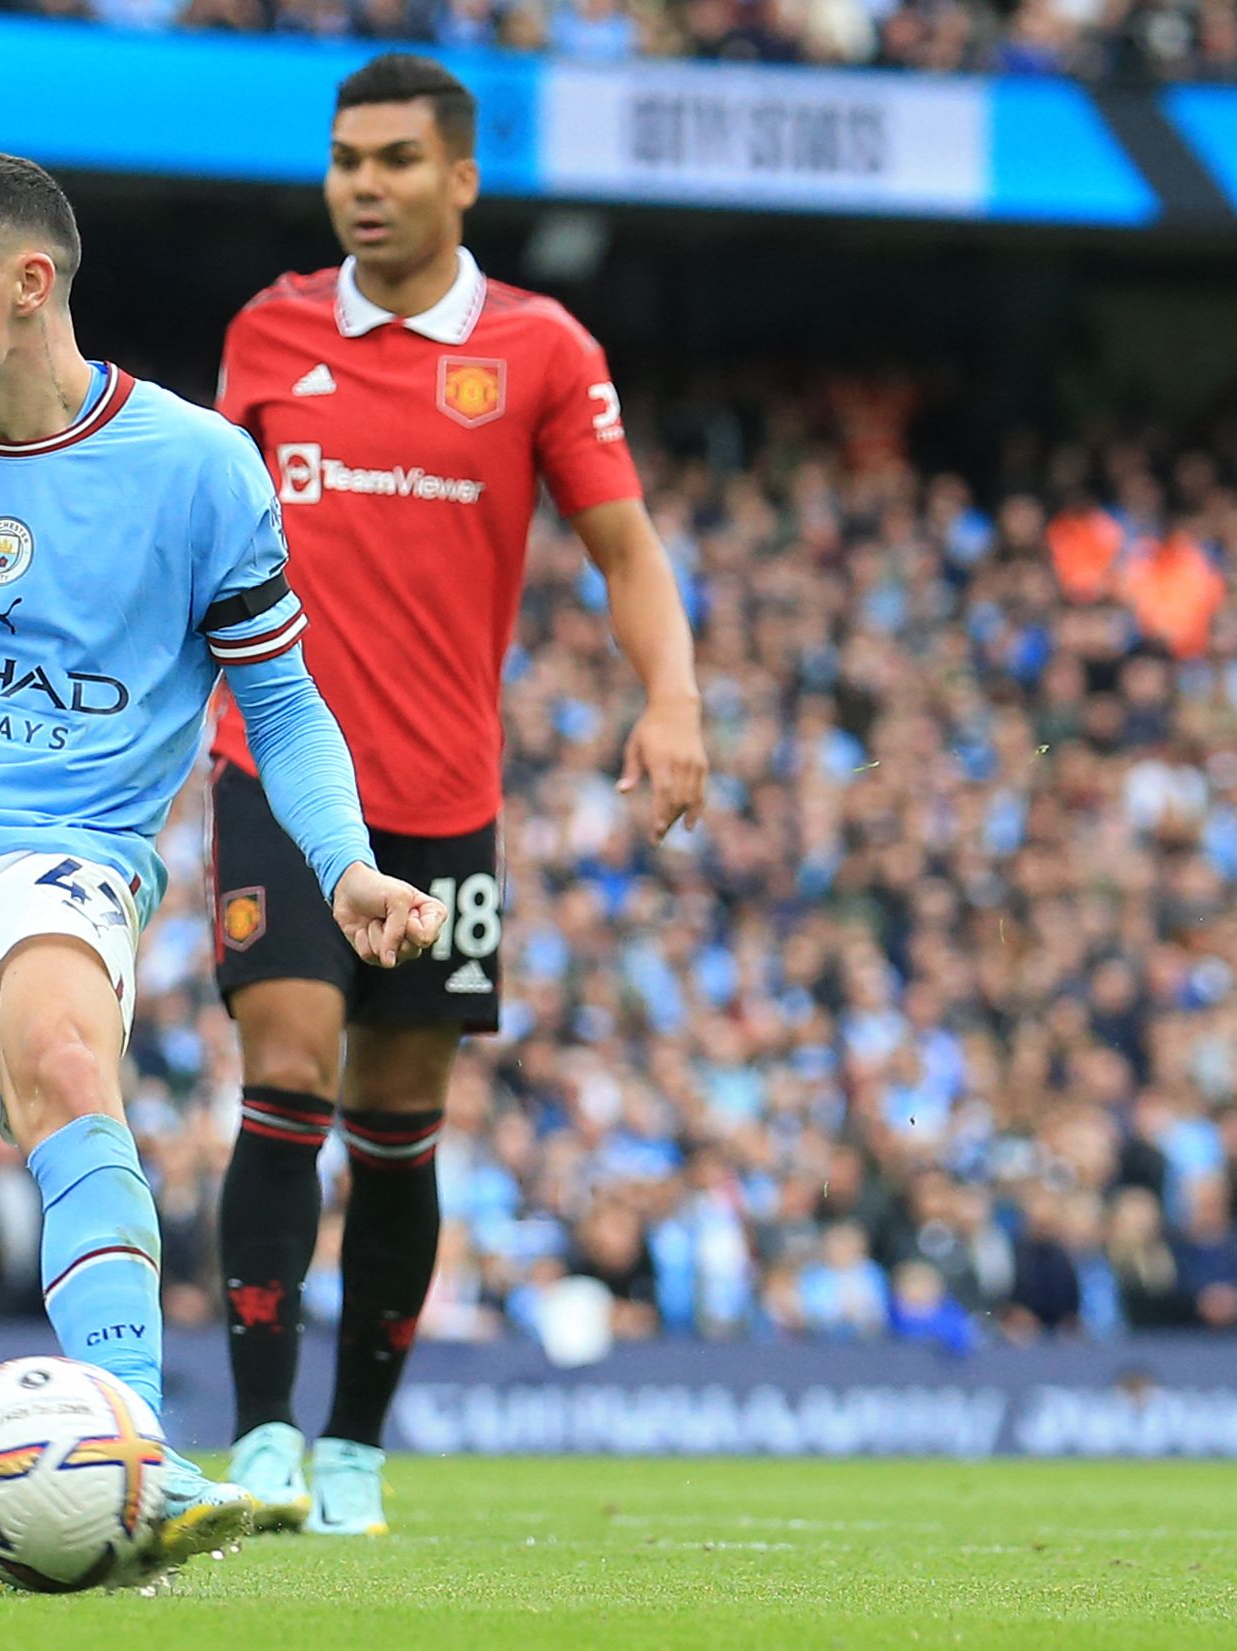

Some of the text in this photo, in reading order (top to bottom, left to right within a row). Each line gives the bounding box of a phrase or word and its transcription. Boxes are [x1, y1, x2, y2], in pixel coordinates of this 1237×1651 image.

[321, 458, 486, 504] TeamViewer
[428, 872, 503, 961] 18
[86, 1323, 146, 1347] CITY
